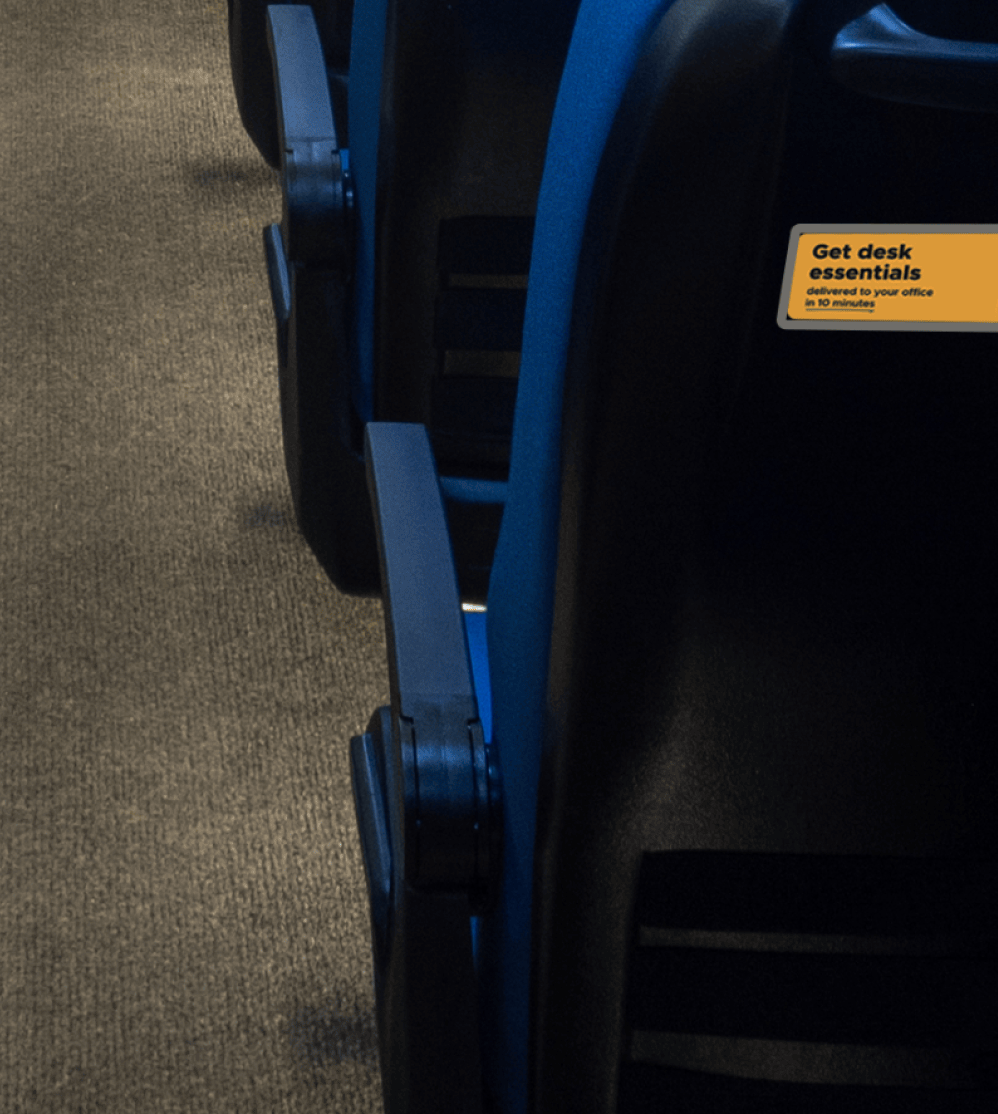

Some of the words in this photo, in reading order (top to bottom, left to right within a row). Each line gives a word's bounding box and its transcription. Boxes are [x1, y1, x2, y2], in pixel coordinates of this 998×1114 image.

[812, 243, 852, 259] Get
[857, 243, 912, 259] desk
[809, 263, 921, 280] essentials
[806, 286, 857, 295] delivered
[860, 288, 871, 296] to
[873, 288, 899, 298] your
[901, 288, 934, 296] office
[805, 298, 815, 307] in
[818, 298, 830, 307] 10
[832, 299, 875, 308] minutes
